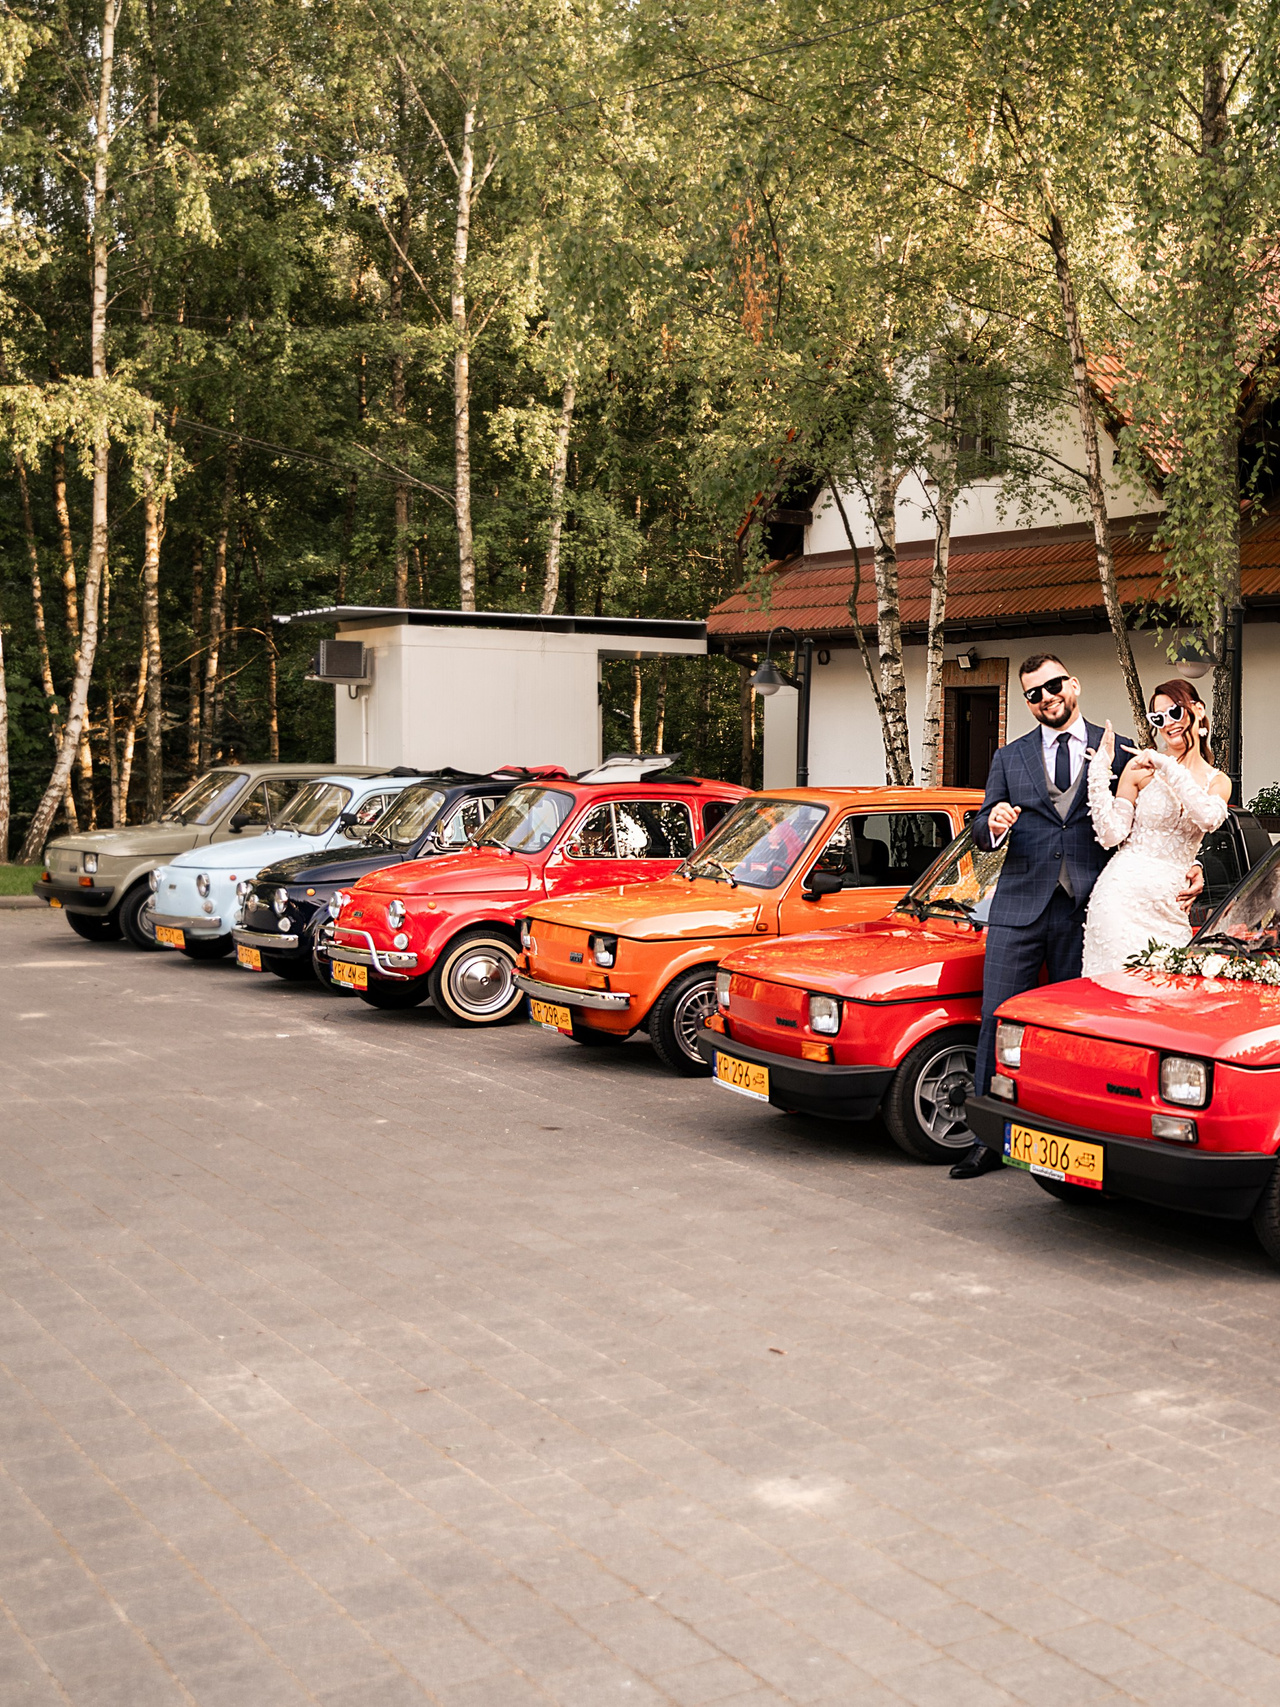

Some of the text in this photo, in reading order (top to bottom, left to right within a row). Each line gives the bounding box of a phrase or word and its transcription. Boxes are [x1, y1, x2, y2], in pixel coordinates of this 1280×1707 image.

[543, 1004, 559, 1025] 298
[717, 1054, 751, 1087] KR 296
[1013, 1128, 1033, 1162] KR
[1039, 1136, 1070, 1171] 306
